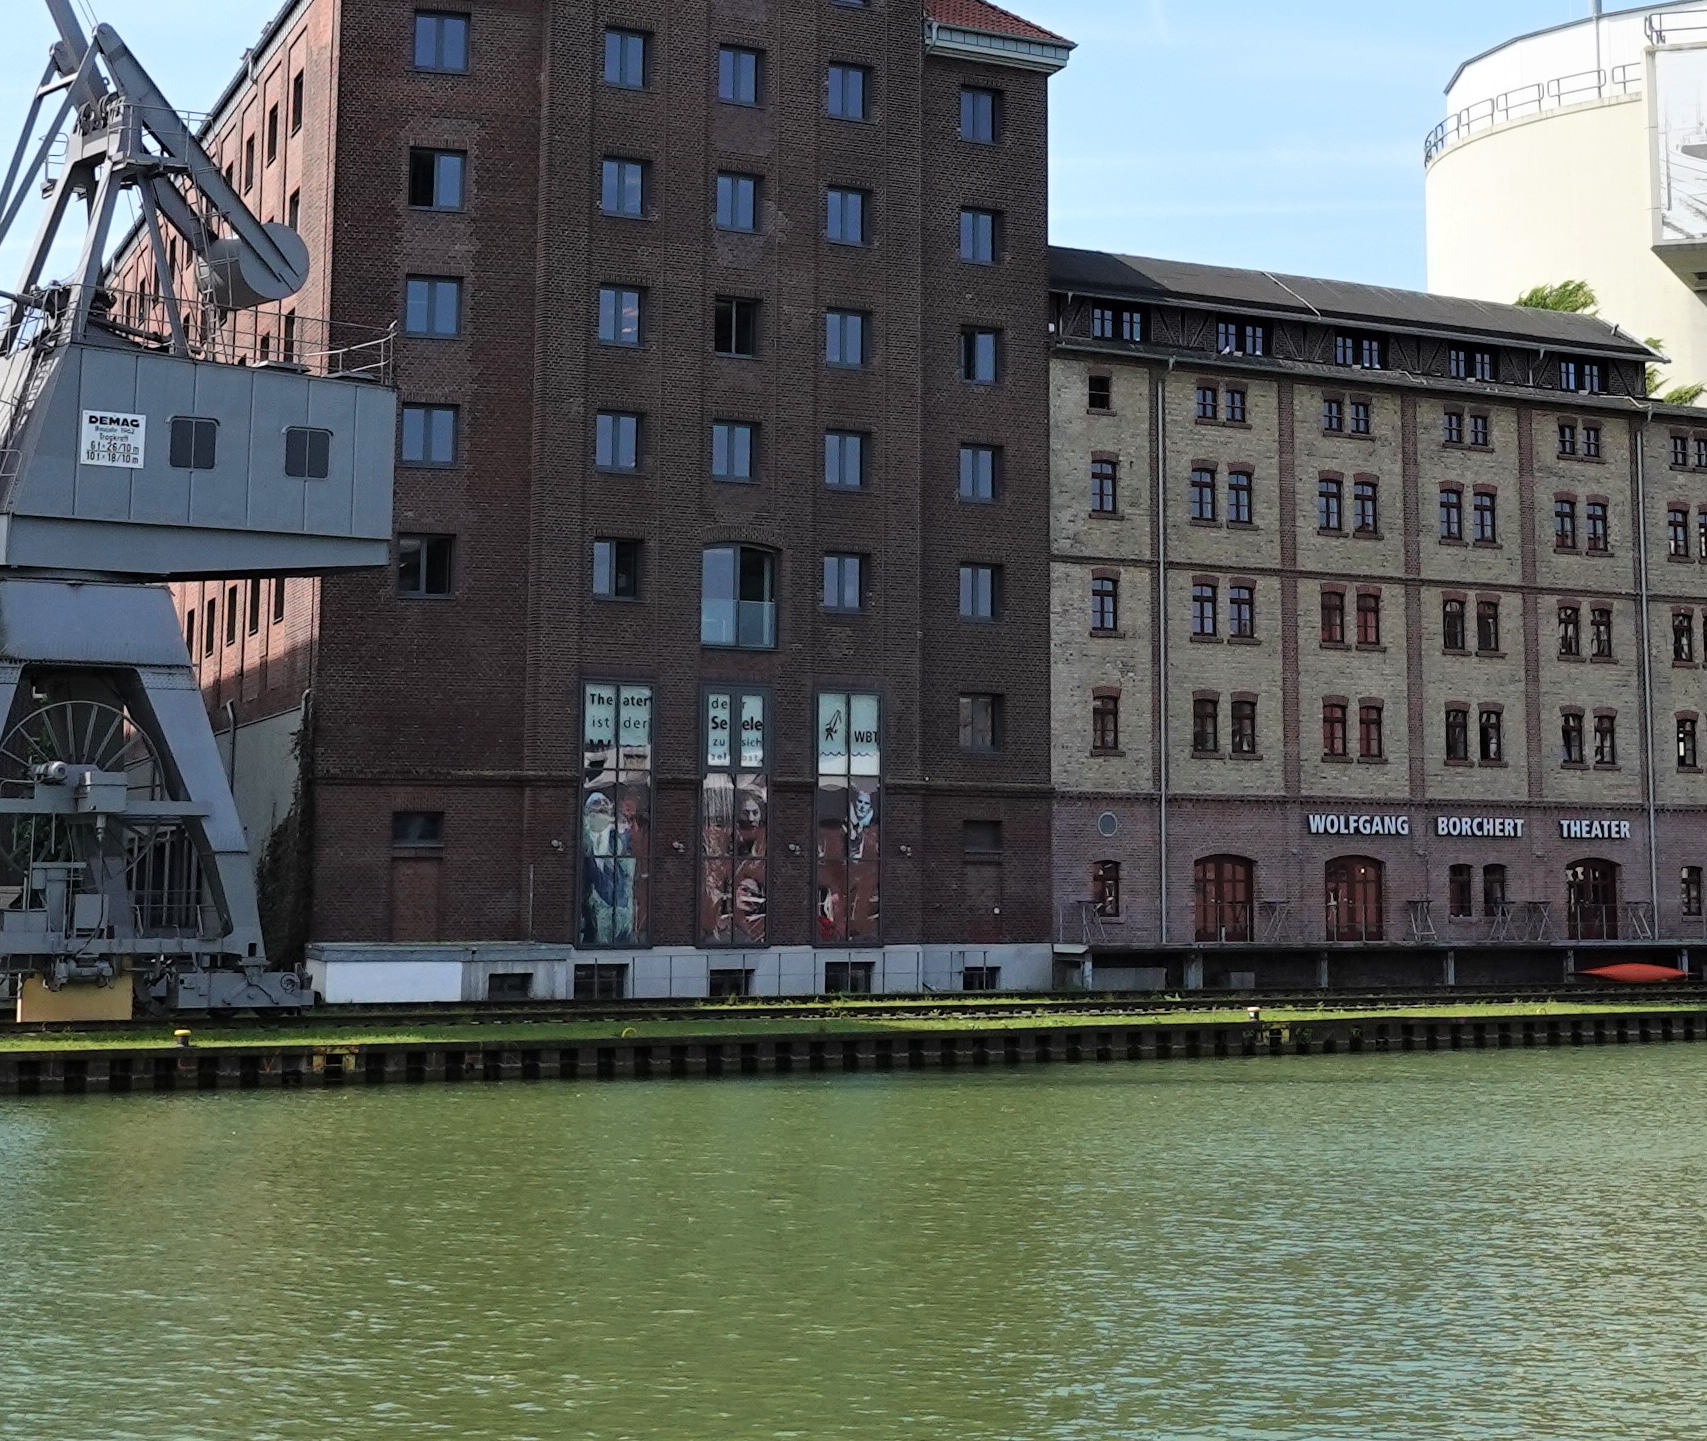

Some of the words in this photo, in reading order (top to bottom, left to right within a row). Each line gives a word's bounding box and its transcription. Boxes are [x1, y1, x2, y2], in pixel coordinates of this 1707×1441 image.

[88, 415, 140, 428] DEMAG
[592, 715, 610, 728] ist
[623, 716, 647, 728] der
[741, 737, 762, 747] sich
[1308, 814, 1409, 835] WOLFGANG
[1437, 816, 1525, 837] BORCHERT
[1560, 819, 1631, 839] THEATER
